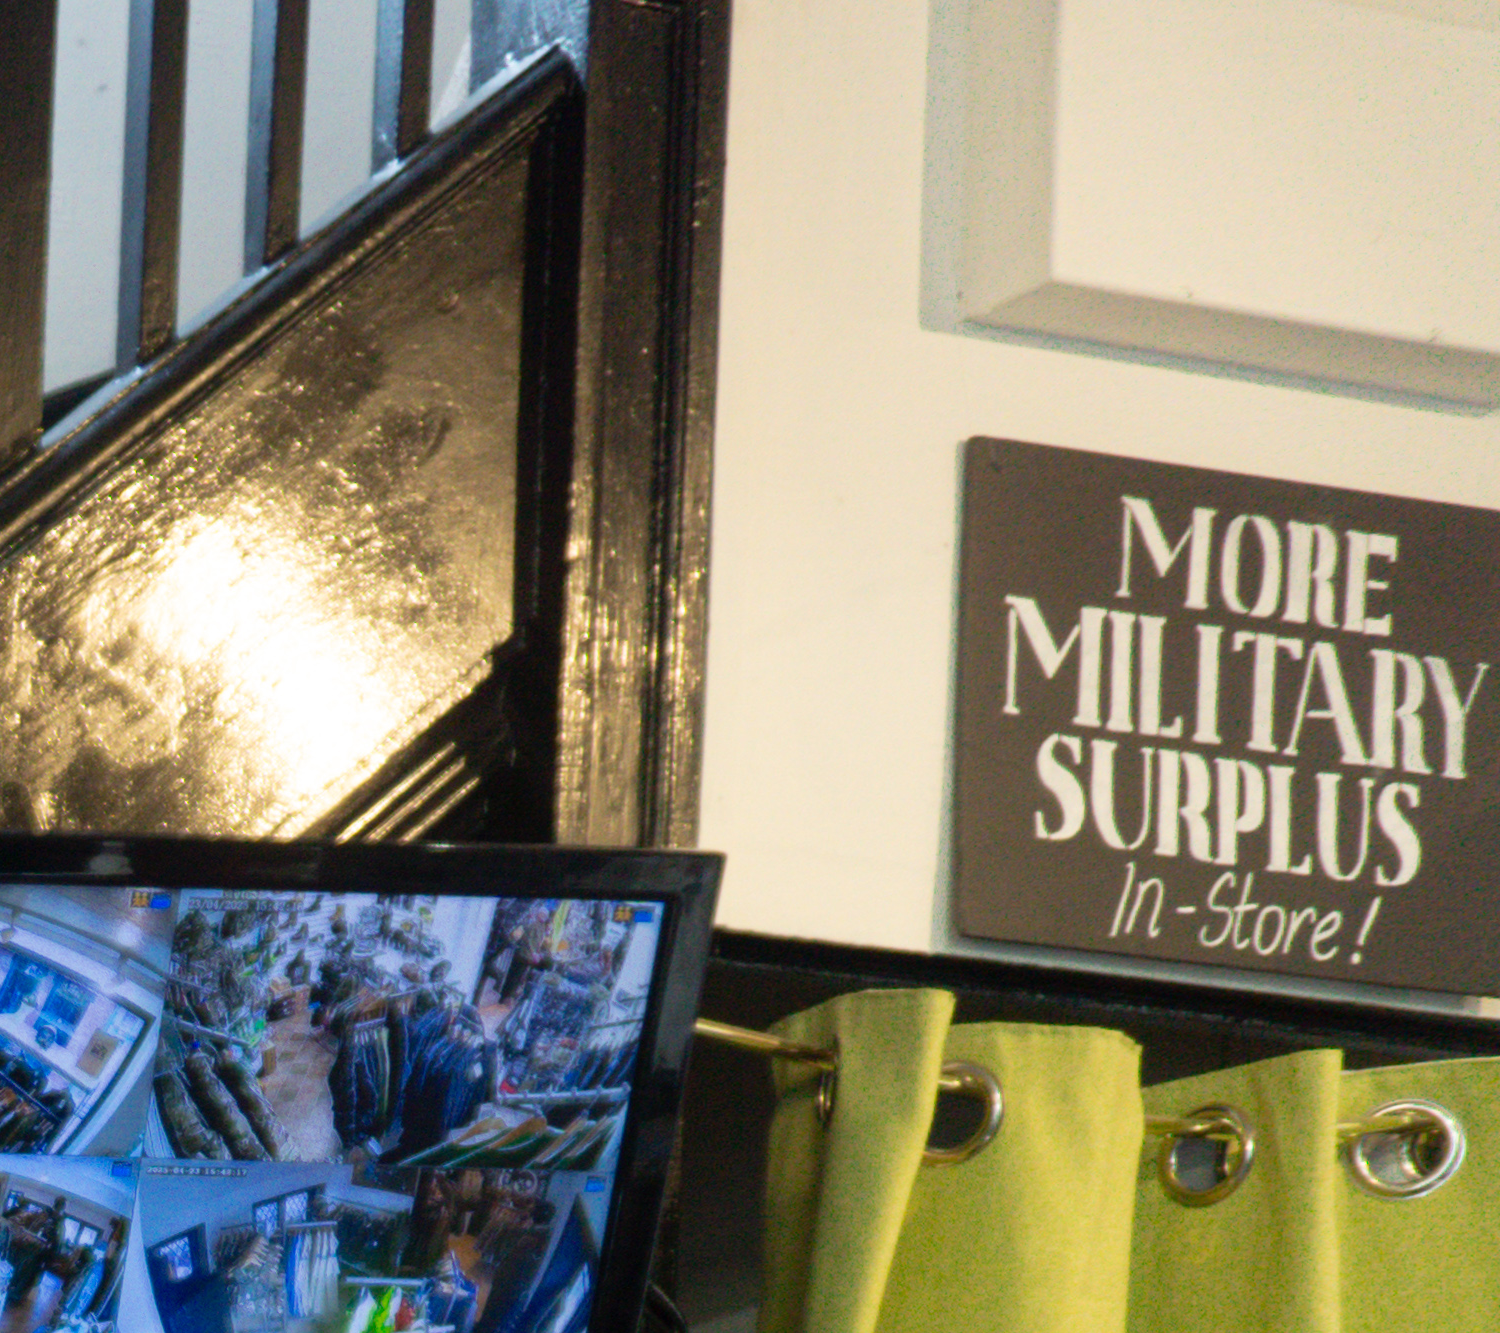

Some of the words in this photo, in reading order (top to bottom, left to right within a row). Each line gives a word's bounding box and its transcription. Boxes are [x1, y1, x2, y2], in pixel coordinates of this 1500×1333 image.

[1116, 494, 1399, 636] MORE
[1003, 594, 1490, 780] MILITARY
[1034, 732, 1422, 887] SURPLUS
